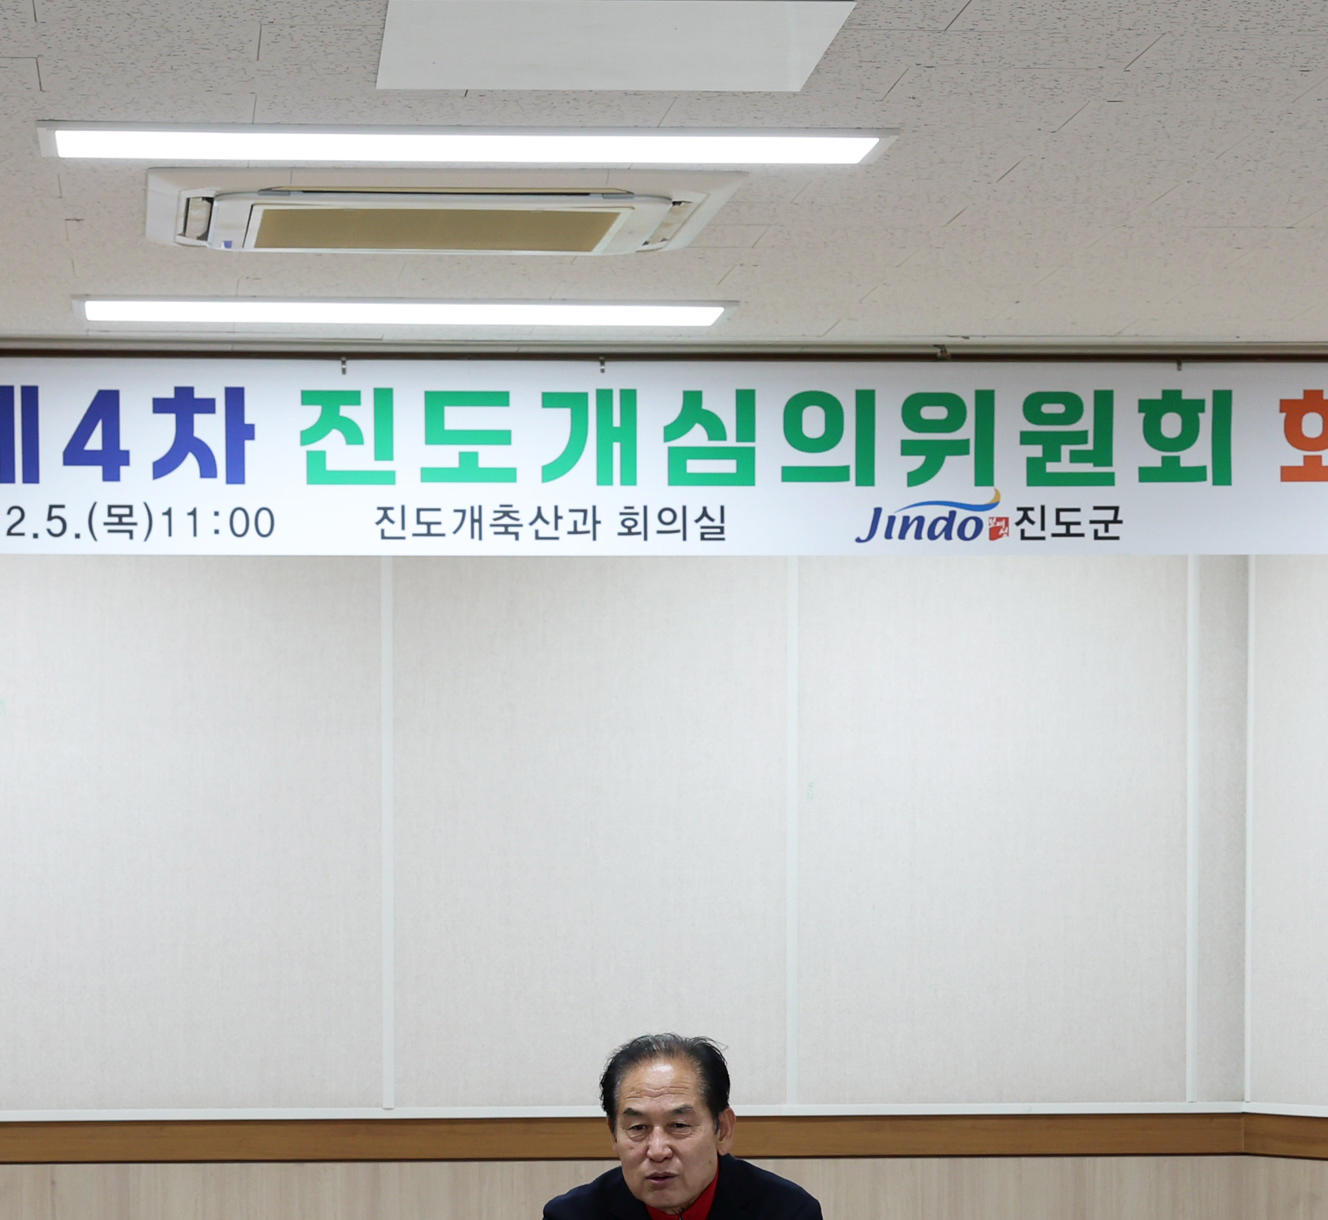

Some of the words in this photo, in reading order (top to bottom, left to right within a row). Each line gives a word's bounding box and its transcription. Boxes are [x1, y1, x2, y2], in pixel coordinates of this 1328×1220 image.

[300, 387, 1233, 487] 진도개심의위원회
[374, 503, 601, 544] 진도개축산과
[616, 503, 728, 543] 회의실
[855, 507, 984, 543] Jindo
[1015, 504, 1124, 541] 진도군
